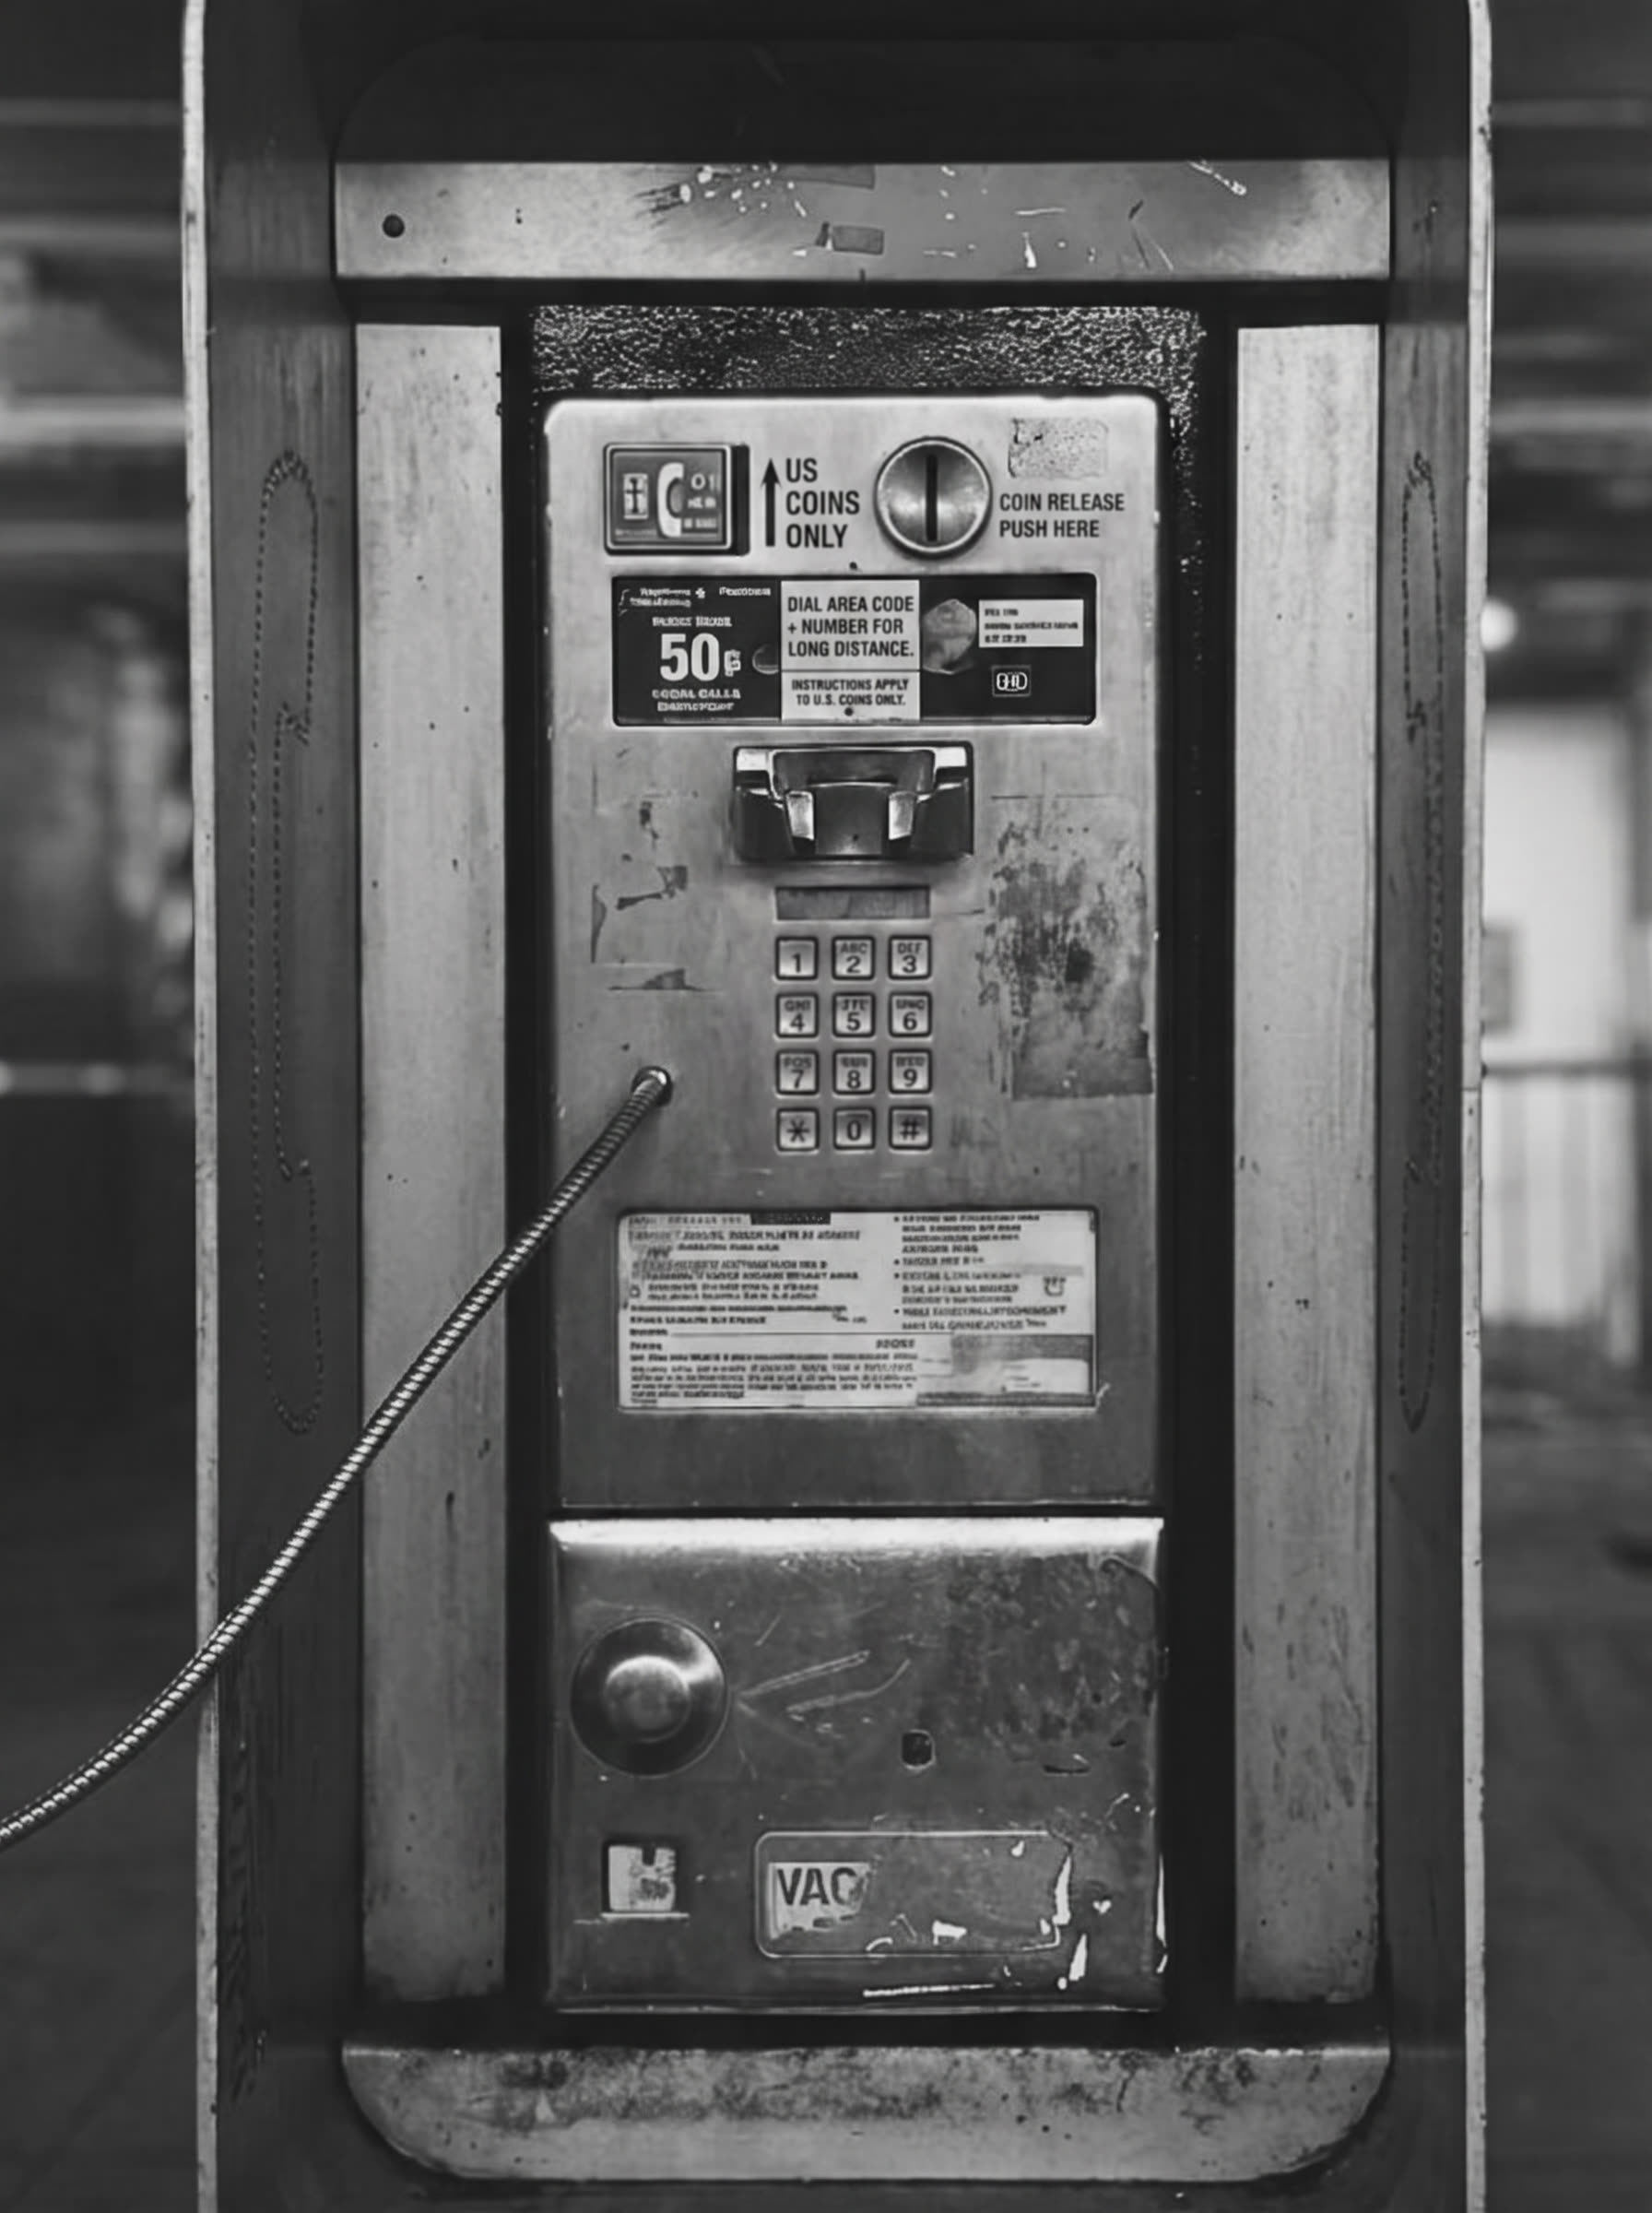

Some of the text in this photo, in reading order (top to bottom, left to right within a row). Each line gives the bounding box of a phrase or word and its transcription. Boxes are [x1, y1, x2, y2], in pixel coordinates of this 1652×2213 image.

[785, 457, 818, 483] US
[785, 490, 860, 515] COINS
[999, 492, 1125, 512] COIN RELEASE
[785, 523, 848, 549] ONLY
[999, 519, 1100, 538] PUSH HERE
[787, 596, 914, 613] DIAL AREA CODE
[801, 618, 868, 635] NUMBER
[872, 618, 903, 635] FOR
[788, 640, 914, 657] LONG DISTANCE.
[791, 678, 909, 692] INSTRUCTIONS APPLY
[796, 692, 905, 707] TO U.S. COINS ONLY.
[793, 953, 917, 974] 1 2 3
[790, 1011, 918, 1033] 4 5 6
[790, 1068, 918, 1090] 7 8 9
[846, 1119, 862, 1142] 0
